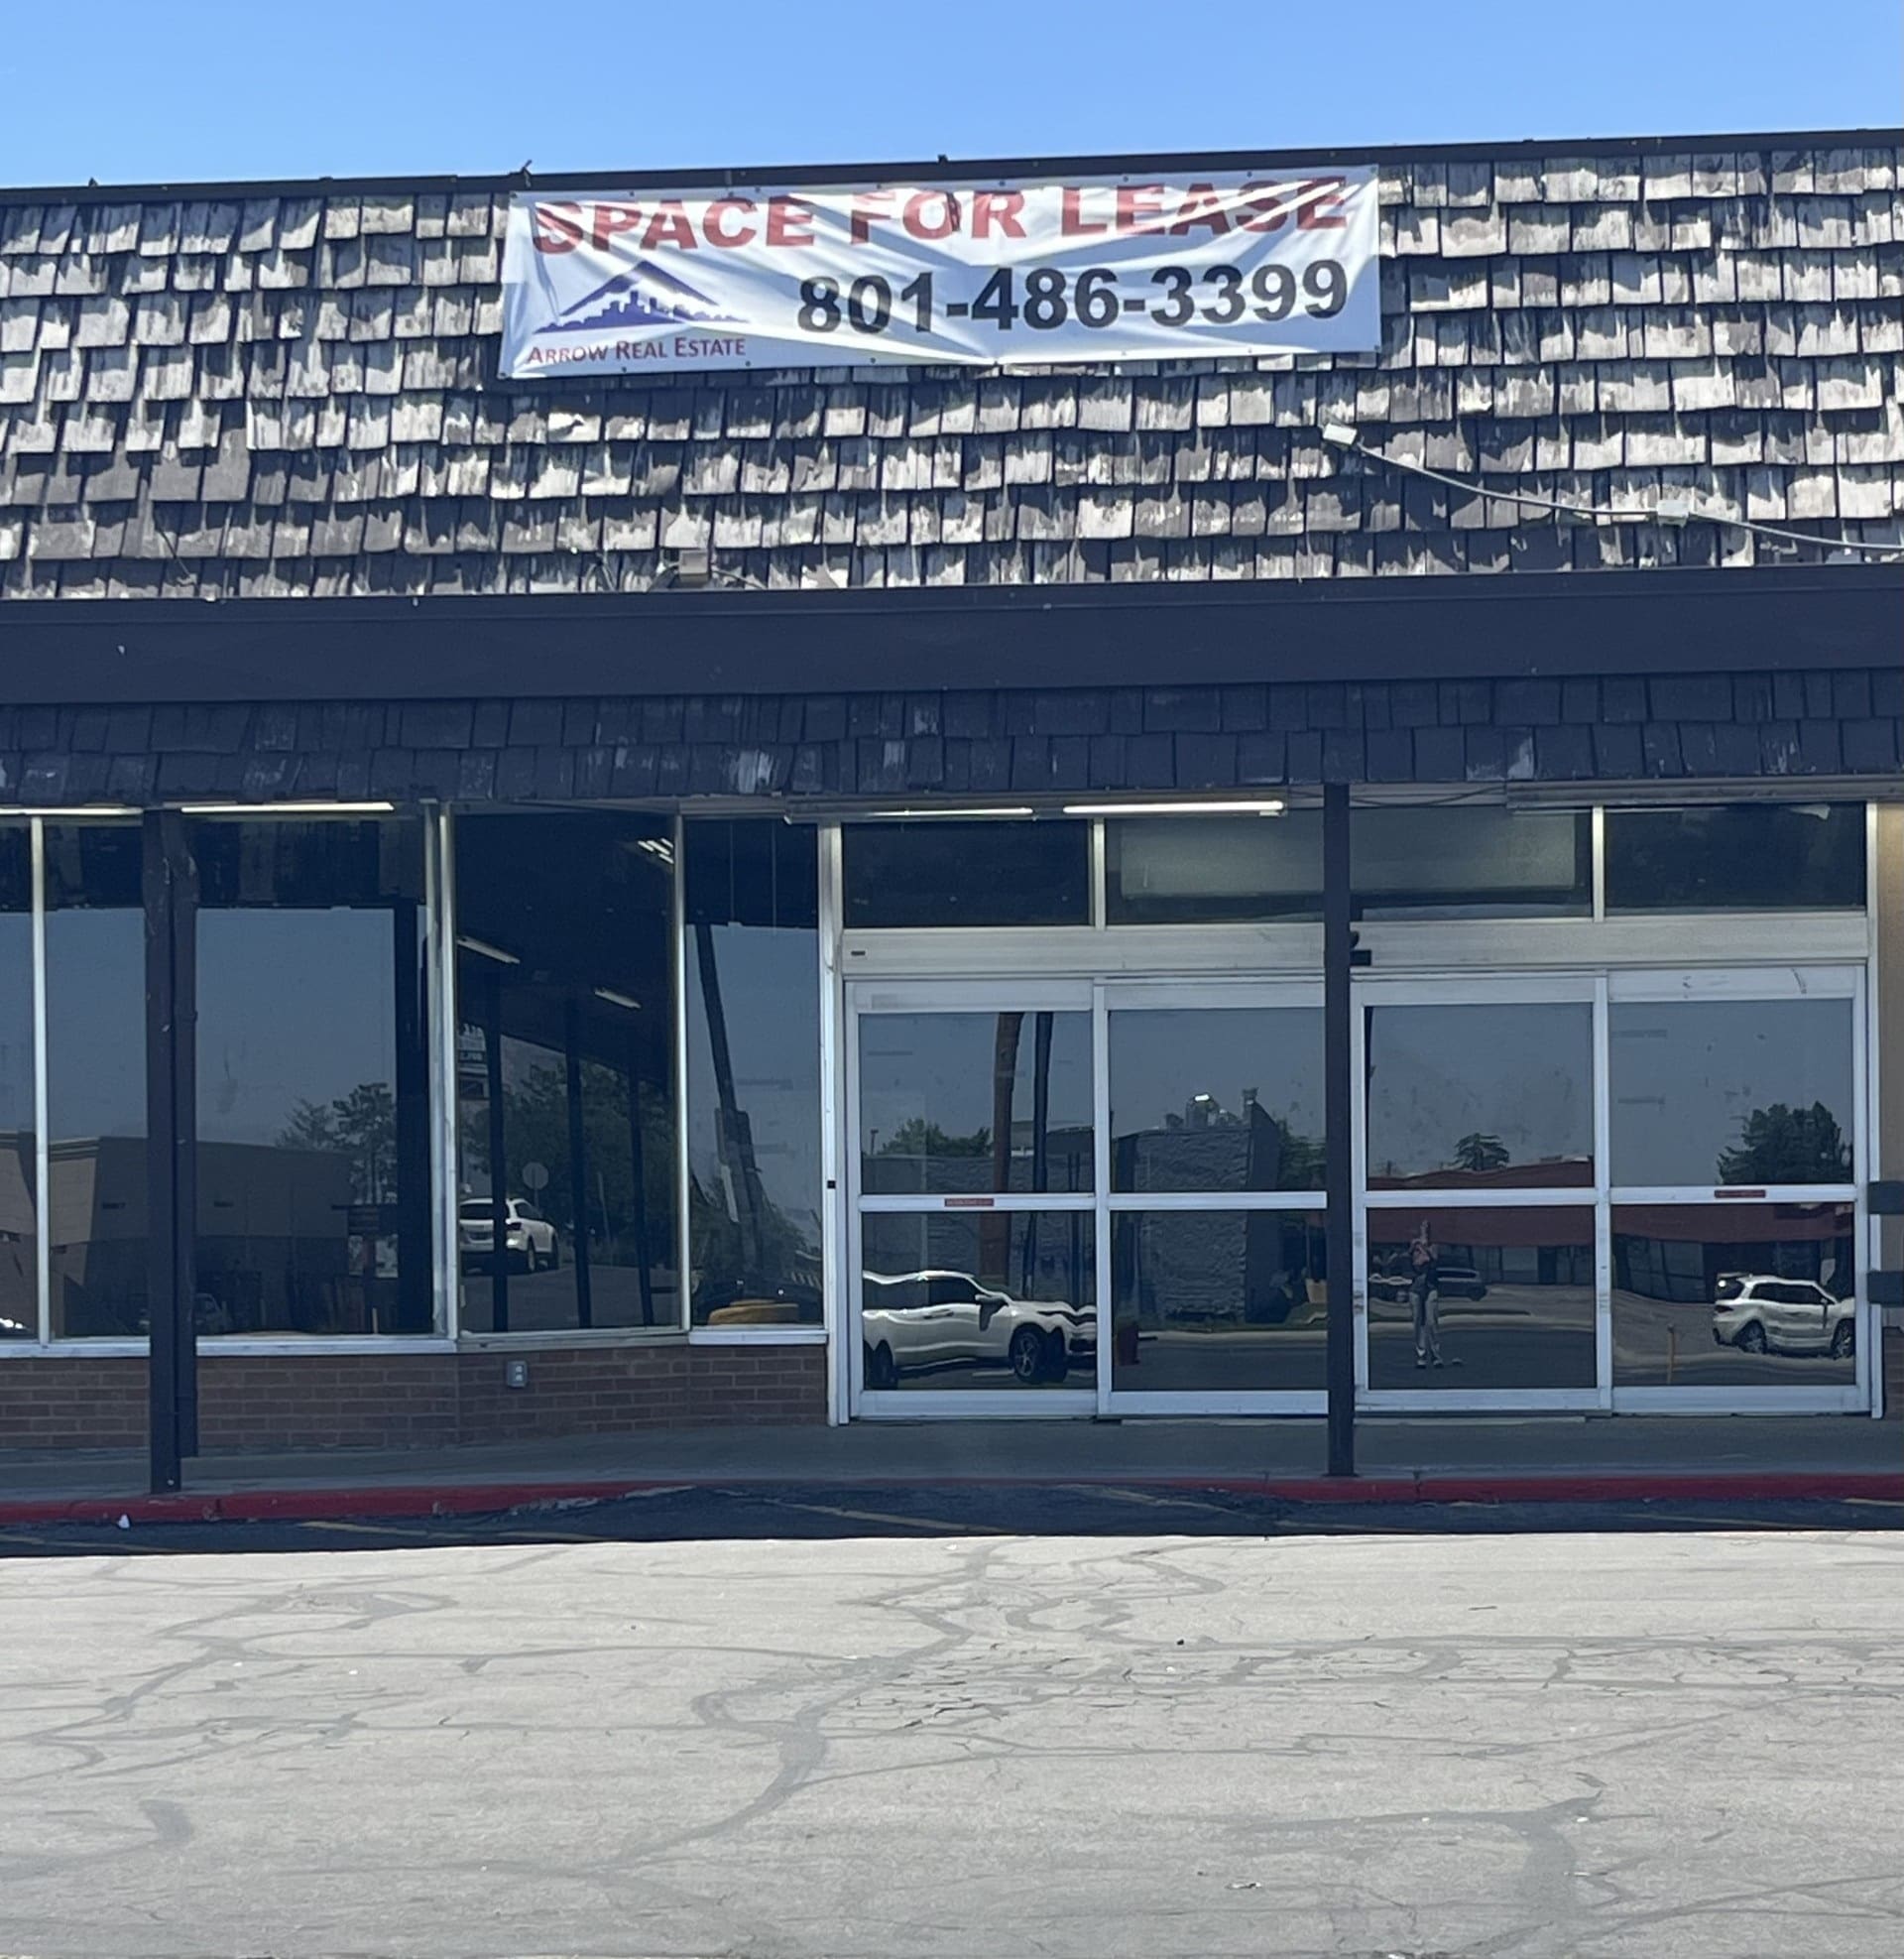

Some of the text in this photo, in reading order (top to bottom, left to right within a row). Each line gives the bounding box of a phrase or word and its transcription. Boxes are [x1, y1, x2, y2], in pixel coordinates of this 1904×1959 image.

[533, 176, 1348, 255] SPACE FOR LEASE
[796, 259, 1348, 334] 801-486-3399
[526, 336, 747, 365] ARROW REAL ESTATE
